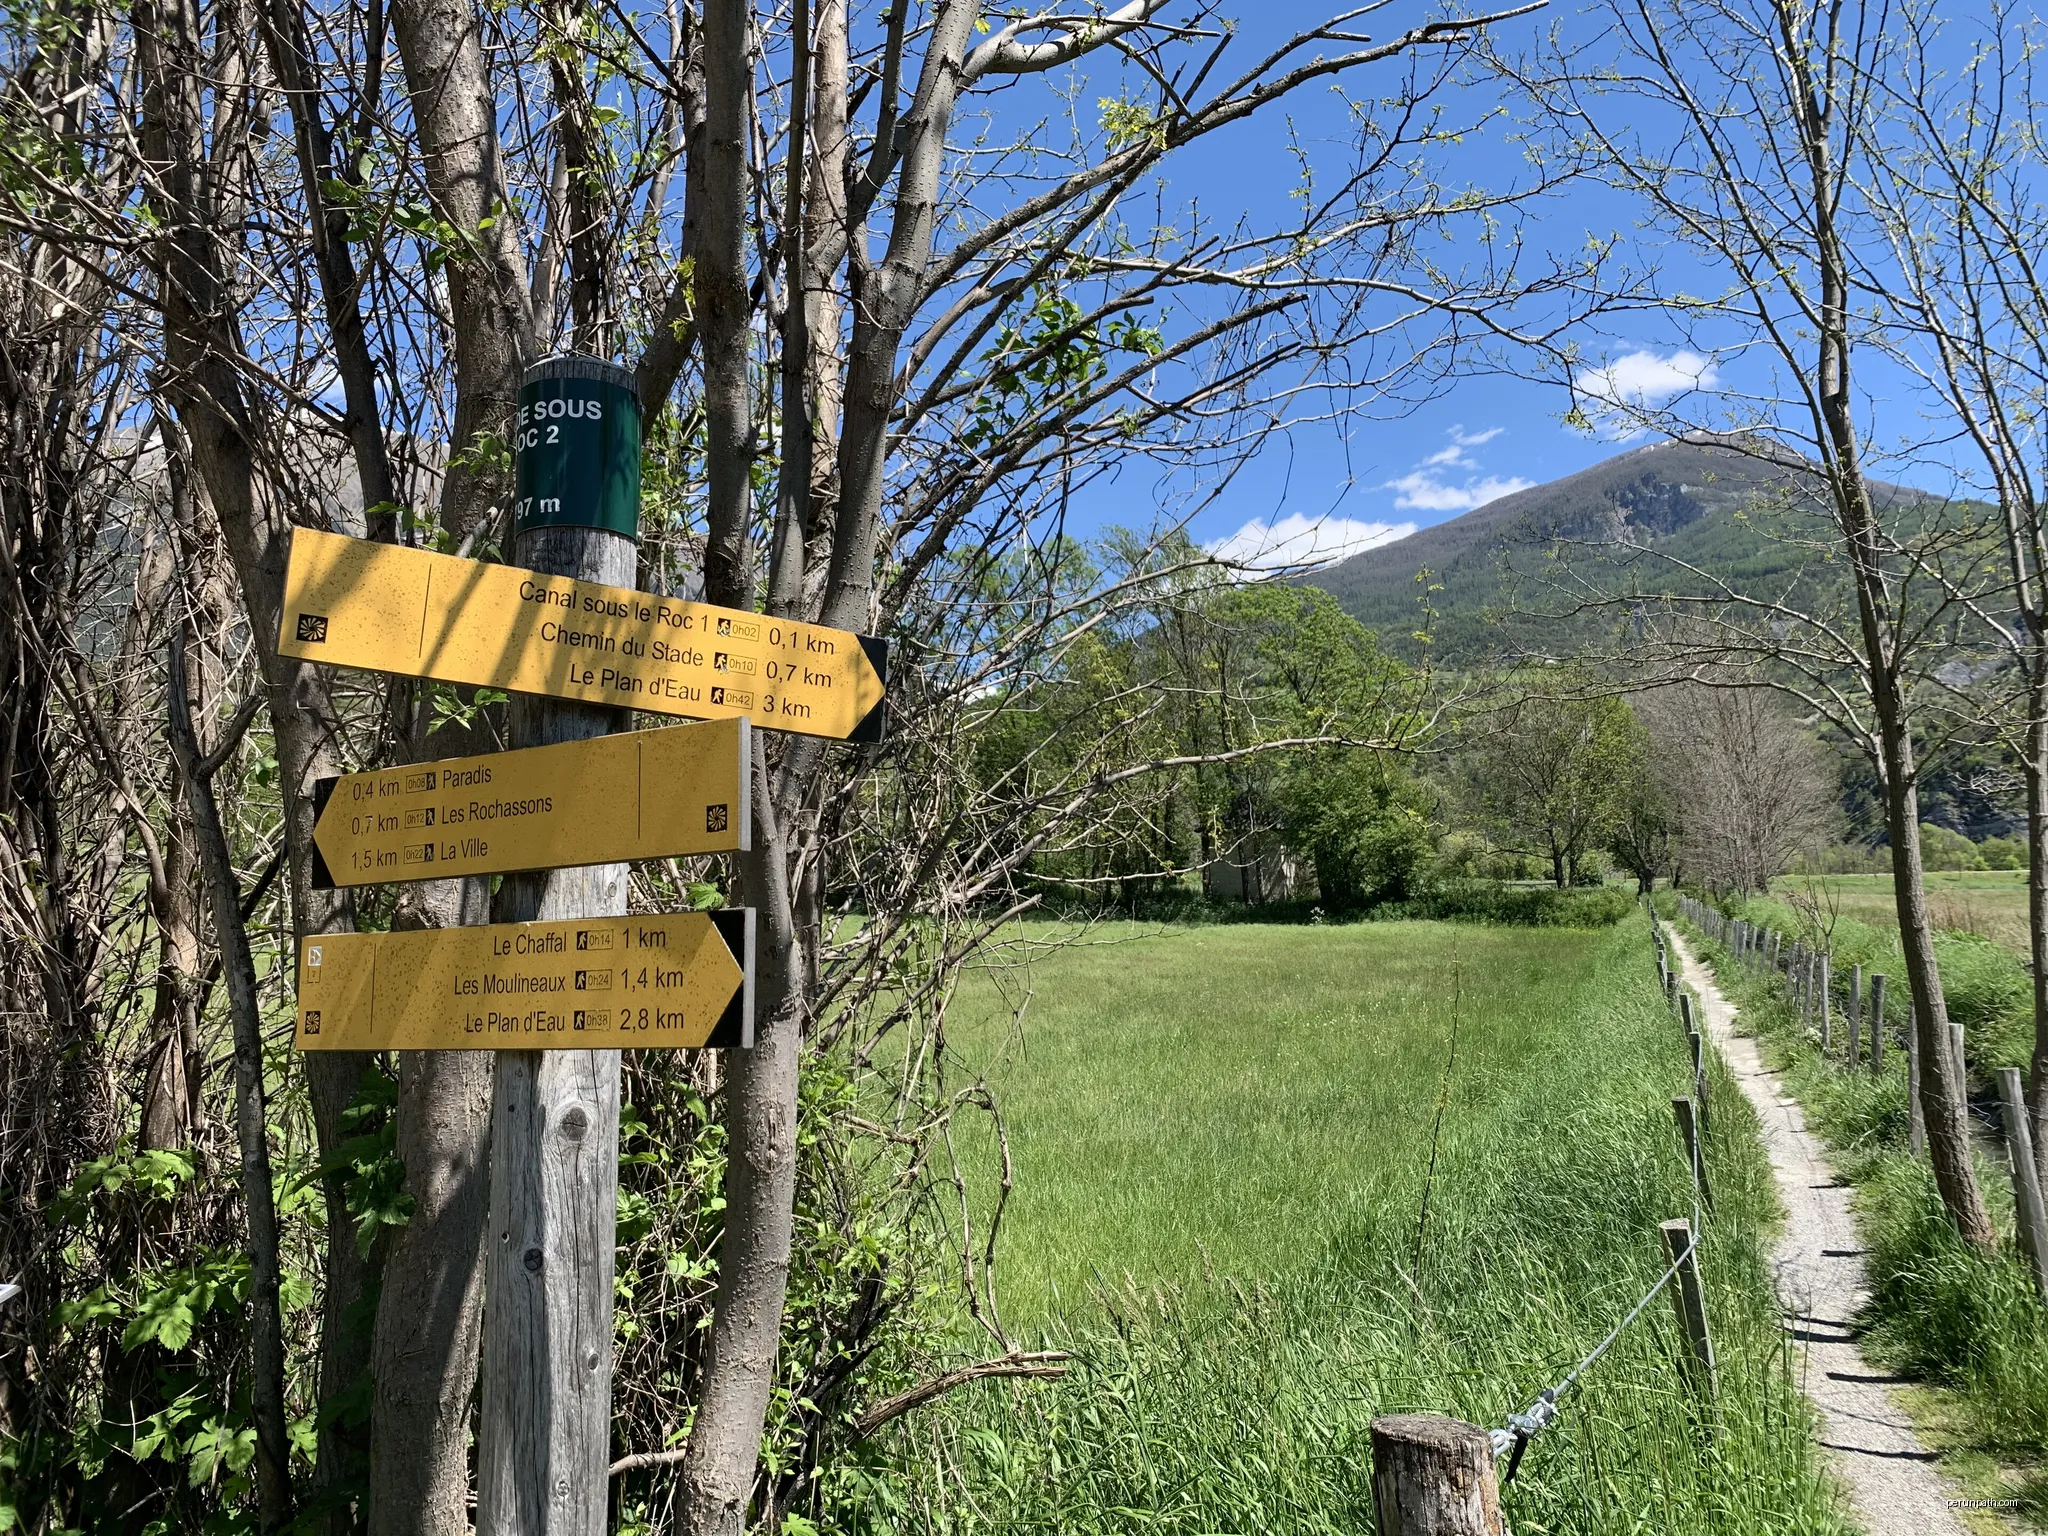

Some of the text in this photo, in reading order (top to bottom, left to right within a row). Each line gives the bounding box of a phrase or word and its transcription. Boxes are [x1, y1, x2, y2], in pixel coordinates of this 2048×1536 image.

[533, 399, 602, 420] SOUS
[516, 425, 560, 455] OC 2
[515, 497, 561, 520] 97 m
[519, 580, 835, 655] Canal sous le Roc 1 0h02 0,1 km
[541, 622, 832, 688] Chemin du Stade 0h10 0,7 km
[570, 663, 811, 718] Le Plan d'Eau 0h42 3 km
[353, 780, 374, 802] 0,4
[379, 779, 400, 797] km
[443, 764, 492, 789] Paradis
[351, 796, 553, 837] 0,7 km 0h12 Les Rochassons
[351, 837, 488, 872] 1,5 km 0h22 La Ville
[494, 926, 667, 956] Le Chaffal 0h14 1 km
[454, 965, 684, 996] Les Moulineaux 0h24 1,4 km
[466, 1007, 684, 1034] Le Plan d'Eau 0h38 2,8 km
